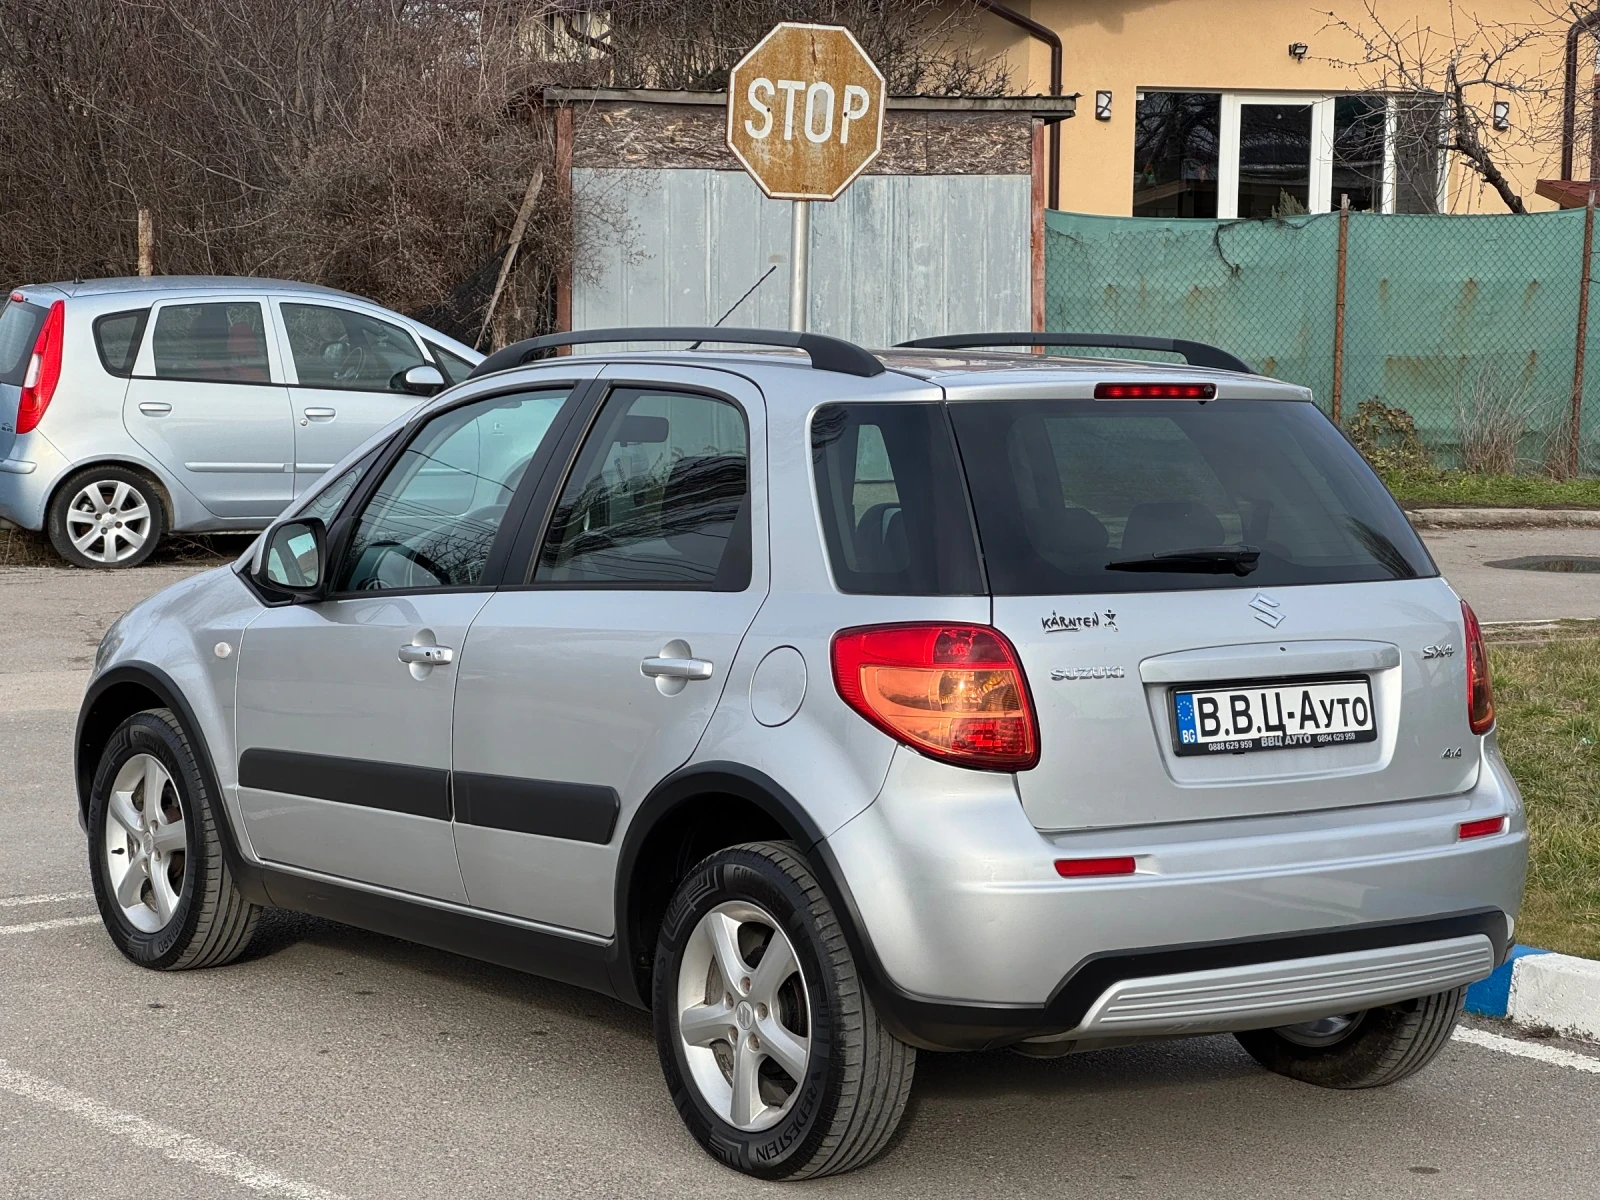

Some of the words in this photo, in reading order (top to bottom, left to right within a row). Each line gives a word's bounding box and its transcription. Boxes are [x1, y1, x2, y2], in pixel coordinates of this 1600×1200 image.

[744, 77, 870, 144] STOP
[1422, 643, 1455, 660] SX4
[1050, 665, 1125, 681] SUZUKI
[1182, 729, 1196, 743] BG
[1261, 735, 1283, 747] ВВЦ
[1285, 733, 1312, 745] АУТО
[1317, 734, 1333, 743] 0894
[1333, 733, 1345, 741] 629
[1345, 732, 1356, 741] 959
[1208, 742, 1225, 751] 0888
[1225, 741, 1239, 750] 629
[1239, 740, 1253, 749] 959
[755, 1071, 822, 1163] VREDESTEIN
